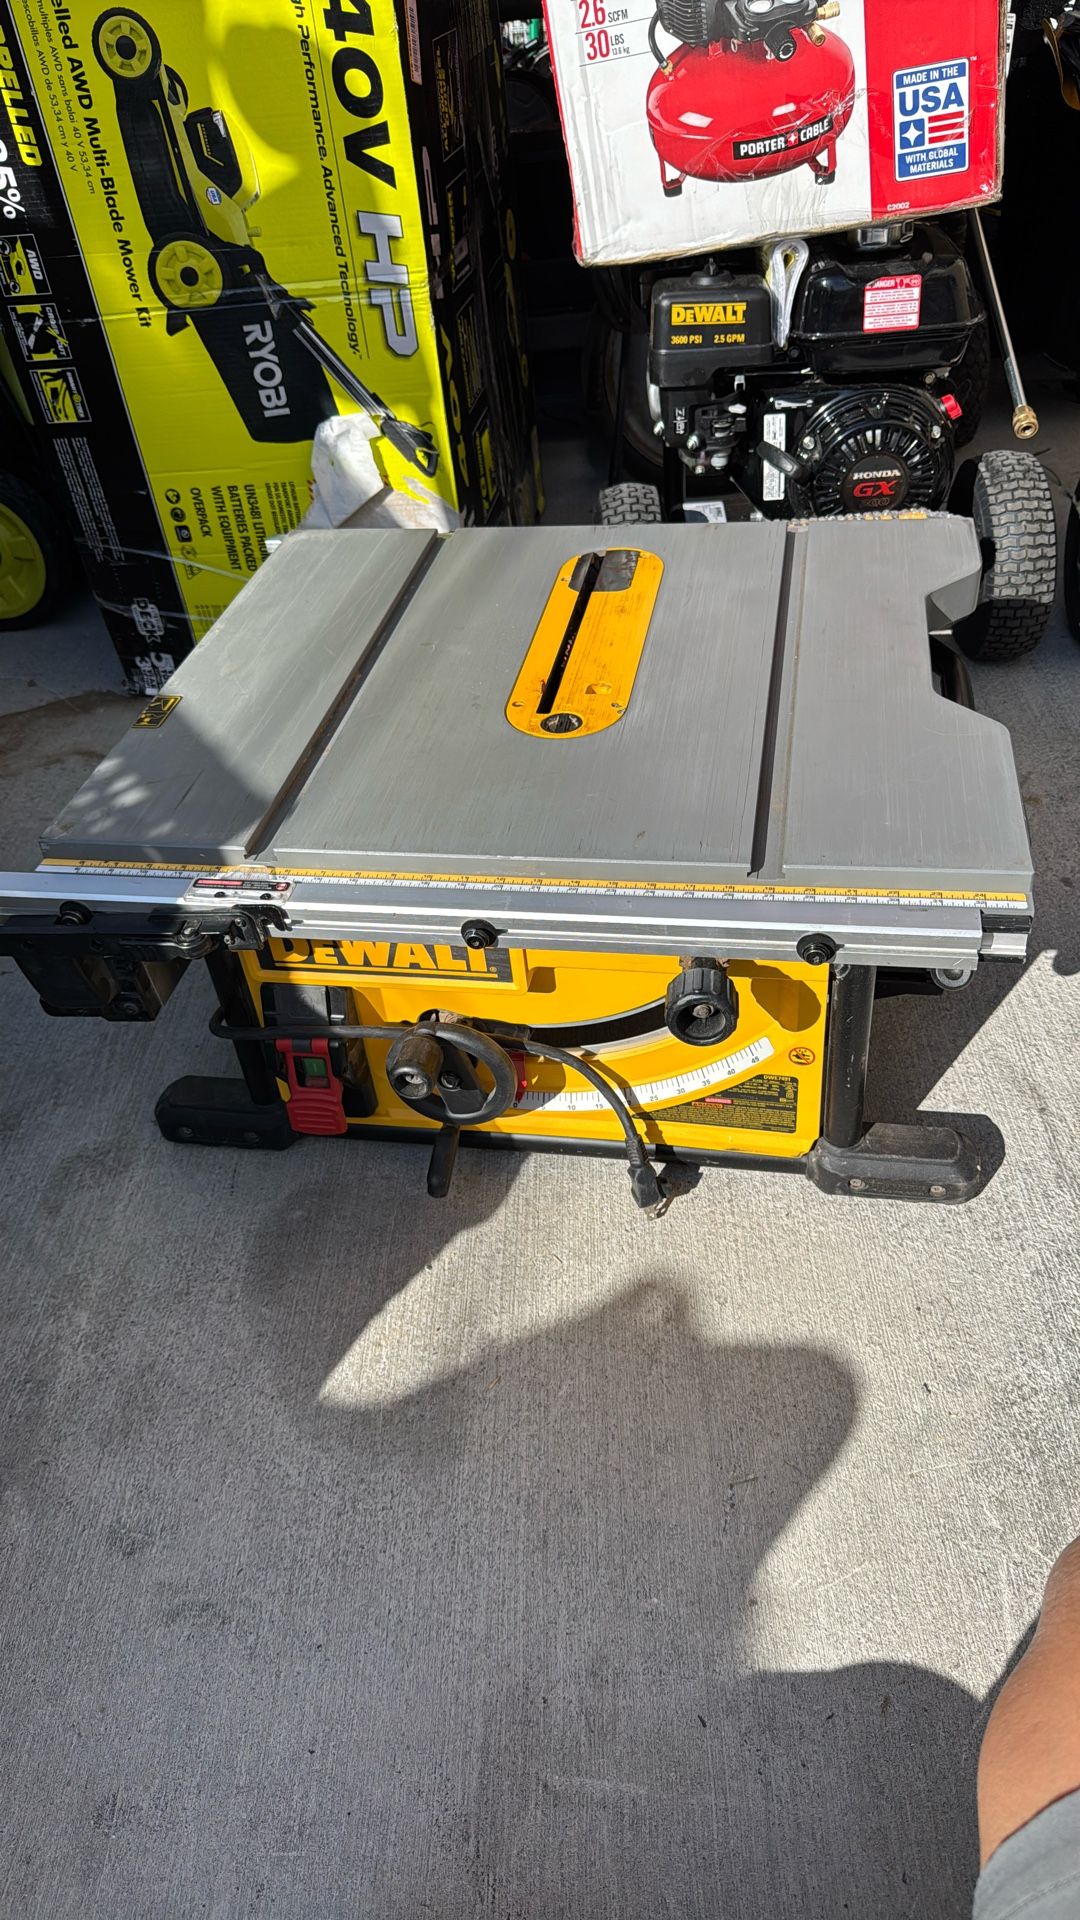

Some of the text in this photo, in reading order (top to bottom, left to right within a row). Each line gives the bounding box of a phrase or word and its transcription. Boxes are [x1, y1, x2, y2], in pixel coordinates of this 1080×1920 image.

[579, 0, 628, 29] 2.6 SCFM
[585, 29, 625, 60] 30 LBS
[36, 49, 50, 75] AWD
[50, 45, 63, 72] AWD
[45, 77, 53, 92] de
[57, 73, 68, 97] sans
[902, 66, 959, 86] MADE IN THE
[0, 25, 43, 167] PELLED
[48, 94, 64, 123] 53,34
[898, 82, 965, 117] USA
[65, 99, 78, 124] balai
[57, 126, 67, 140] cm
[72, 126, 82, 139] 40
[76, 140, 85, 149] V
[298, 25, 328, 161] Performance.
[321, 164, 346, 258] Advanced
[740, 118, 831, 156] PORTER CABLE
[65, 150, 75, 163] 40
[78, 150, 91, 178] 53,34
[905, 147, 959, 164] WITH GLOBAL
[910, 159, 954, 174] MATERIALS
[67, 56, 94, 110] AWD
[83, 117, 125, 233] Multi-Blade
[117, 238, 142, 302] Mower
[135, 306, 152, 328] Kit
[87, 180, 96, 194] cm
[887, 202, 910, 211] C2002
[26, 248, 44, 281] AWD
[356, 210, 419, 356] HP
[672, 304, 747, 323] DEWALT
[671, 333, 745, 345] 3600 PSI 2.5 GPM
[242, 320, 291, 418] RYOBI
[853, 469, 901, 480] HONDA
[244, 483, 263, 519] UN3481
[853, 480, 897, 497] GX
[190, 487, 213, 538] OVERPACK
[211, 485, 242, 571] WITH EQUIPMENT
[227, 485, 258, 572] BATTERIES PACKED
[727, 1068, 736, 1076] 40
[751, 1056, 760, 1064] 45
